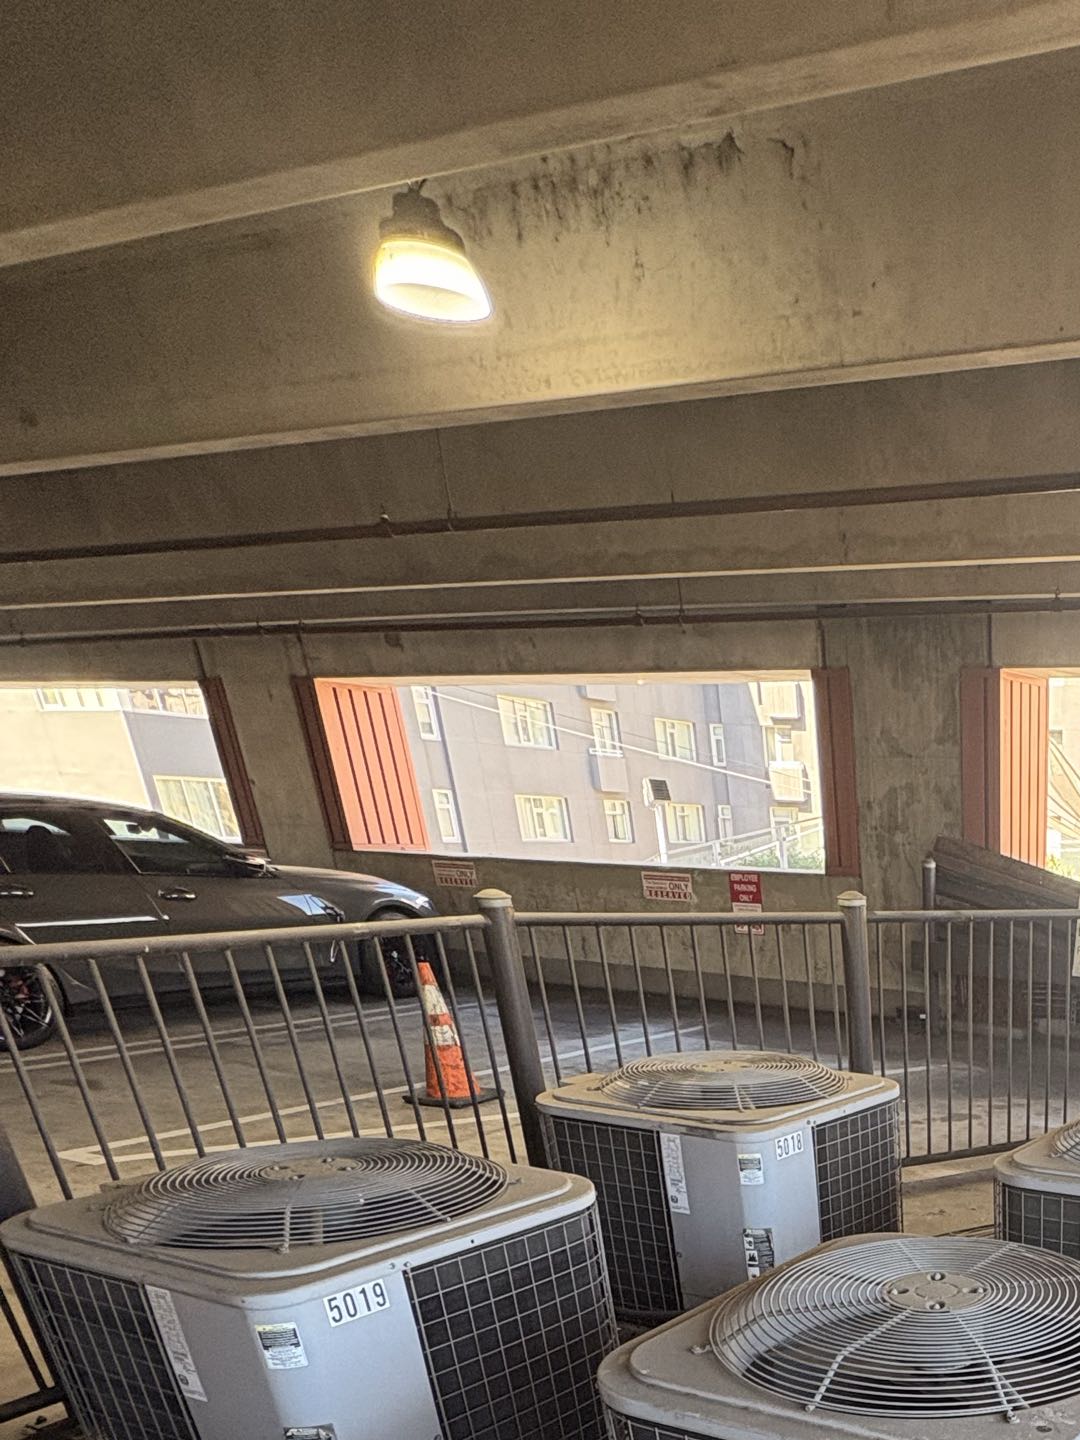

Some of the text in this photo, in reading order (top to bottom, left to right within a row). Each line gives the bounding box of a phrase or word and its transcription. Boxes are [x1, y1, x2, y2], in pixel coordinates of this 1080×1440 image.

[730, 873, 758, 882] EMPLOYEE
[668, 882, 689, 892] ONLY
[733, 883, 757, 892] PARKING
[738, 894, 753, 902] ONLY
[776, 1133, 803, 1157] 5018
[327, 1282, 387, 1323] 5019
